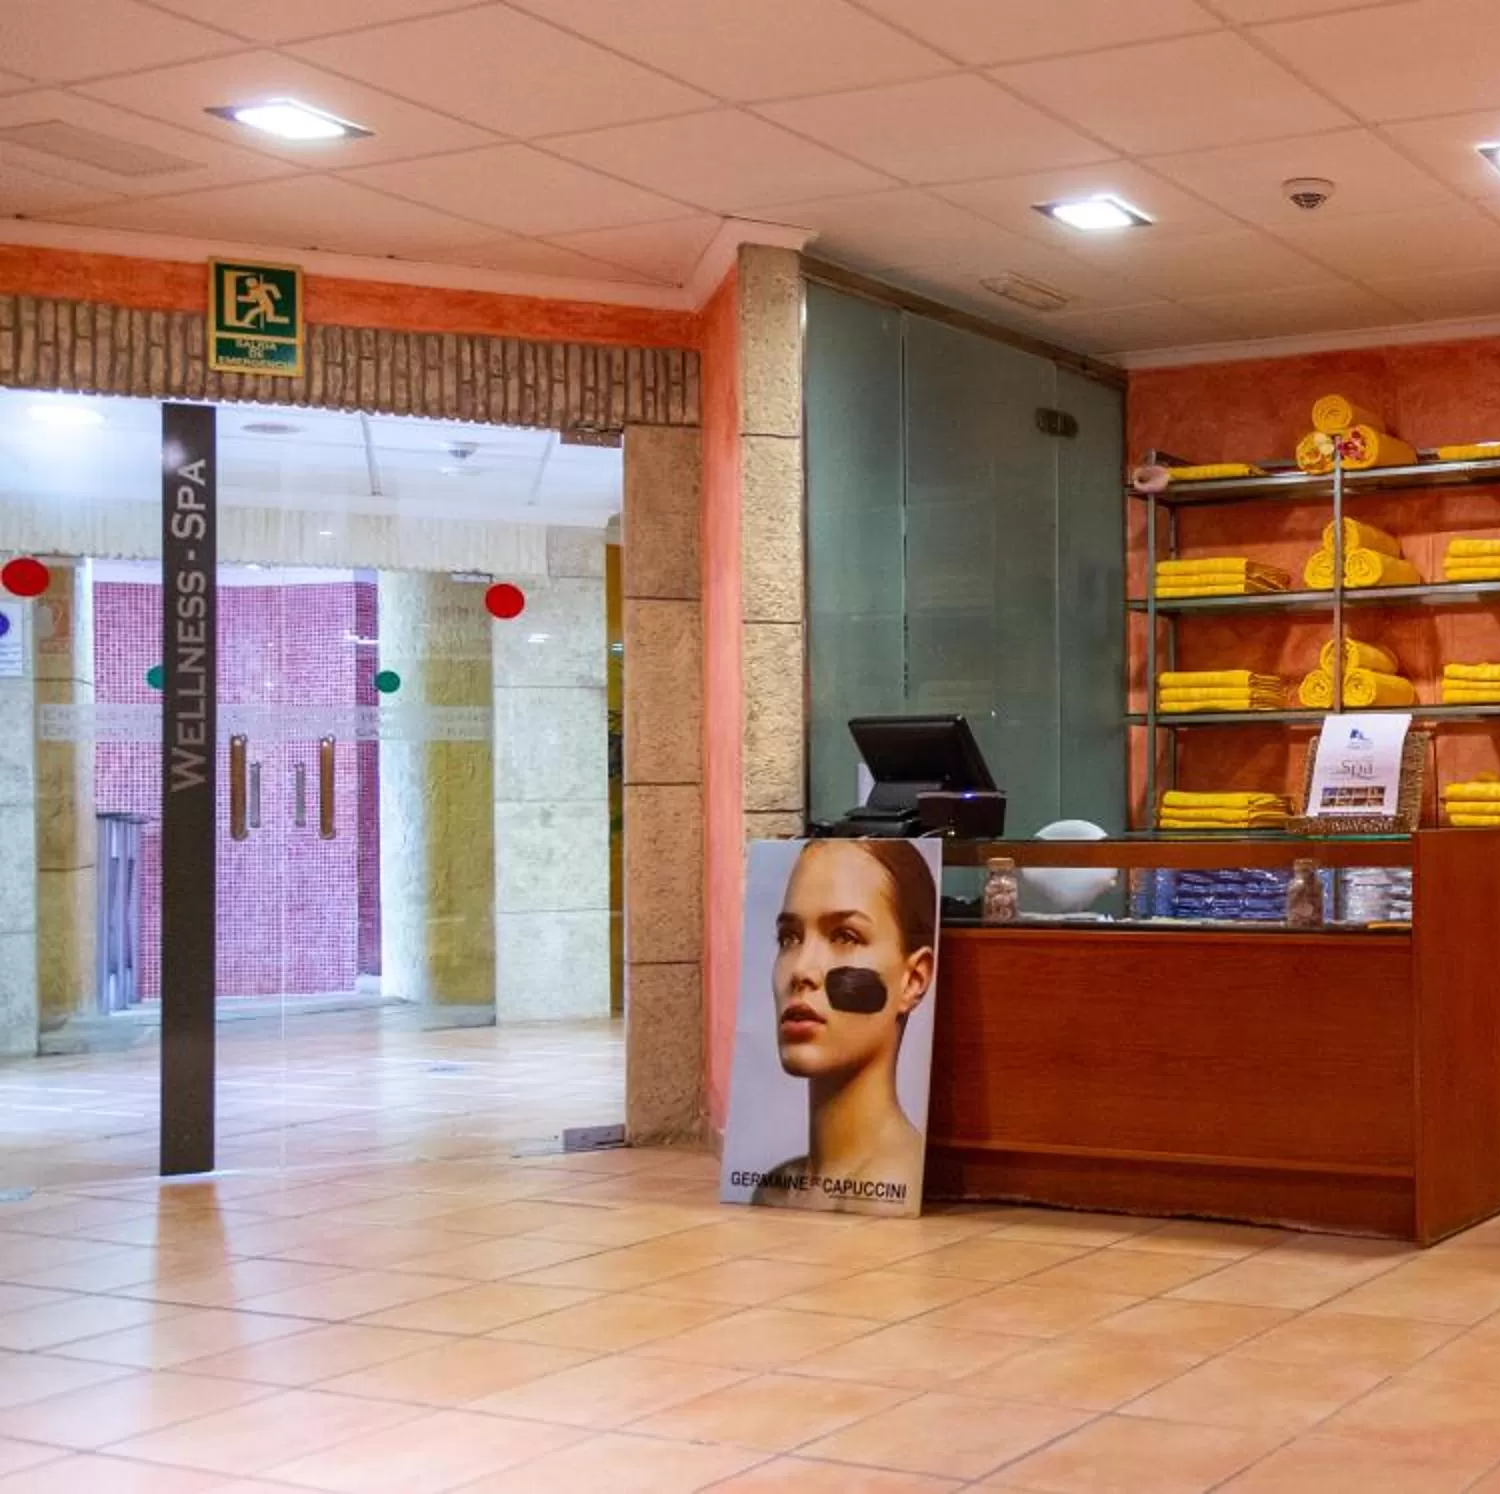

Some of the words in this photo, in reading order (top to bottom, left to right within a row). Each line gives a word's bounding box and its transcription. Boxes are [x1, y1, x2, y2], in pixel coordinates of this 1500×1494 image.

[171, 459, 207, 539] SPA
[170, 569, 207, 792] WELLNESS
[731, 1171, 809, 1191] GERMAINE
[823, 1178, 907, 1199] CAPUCCINI
